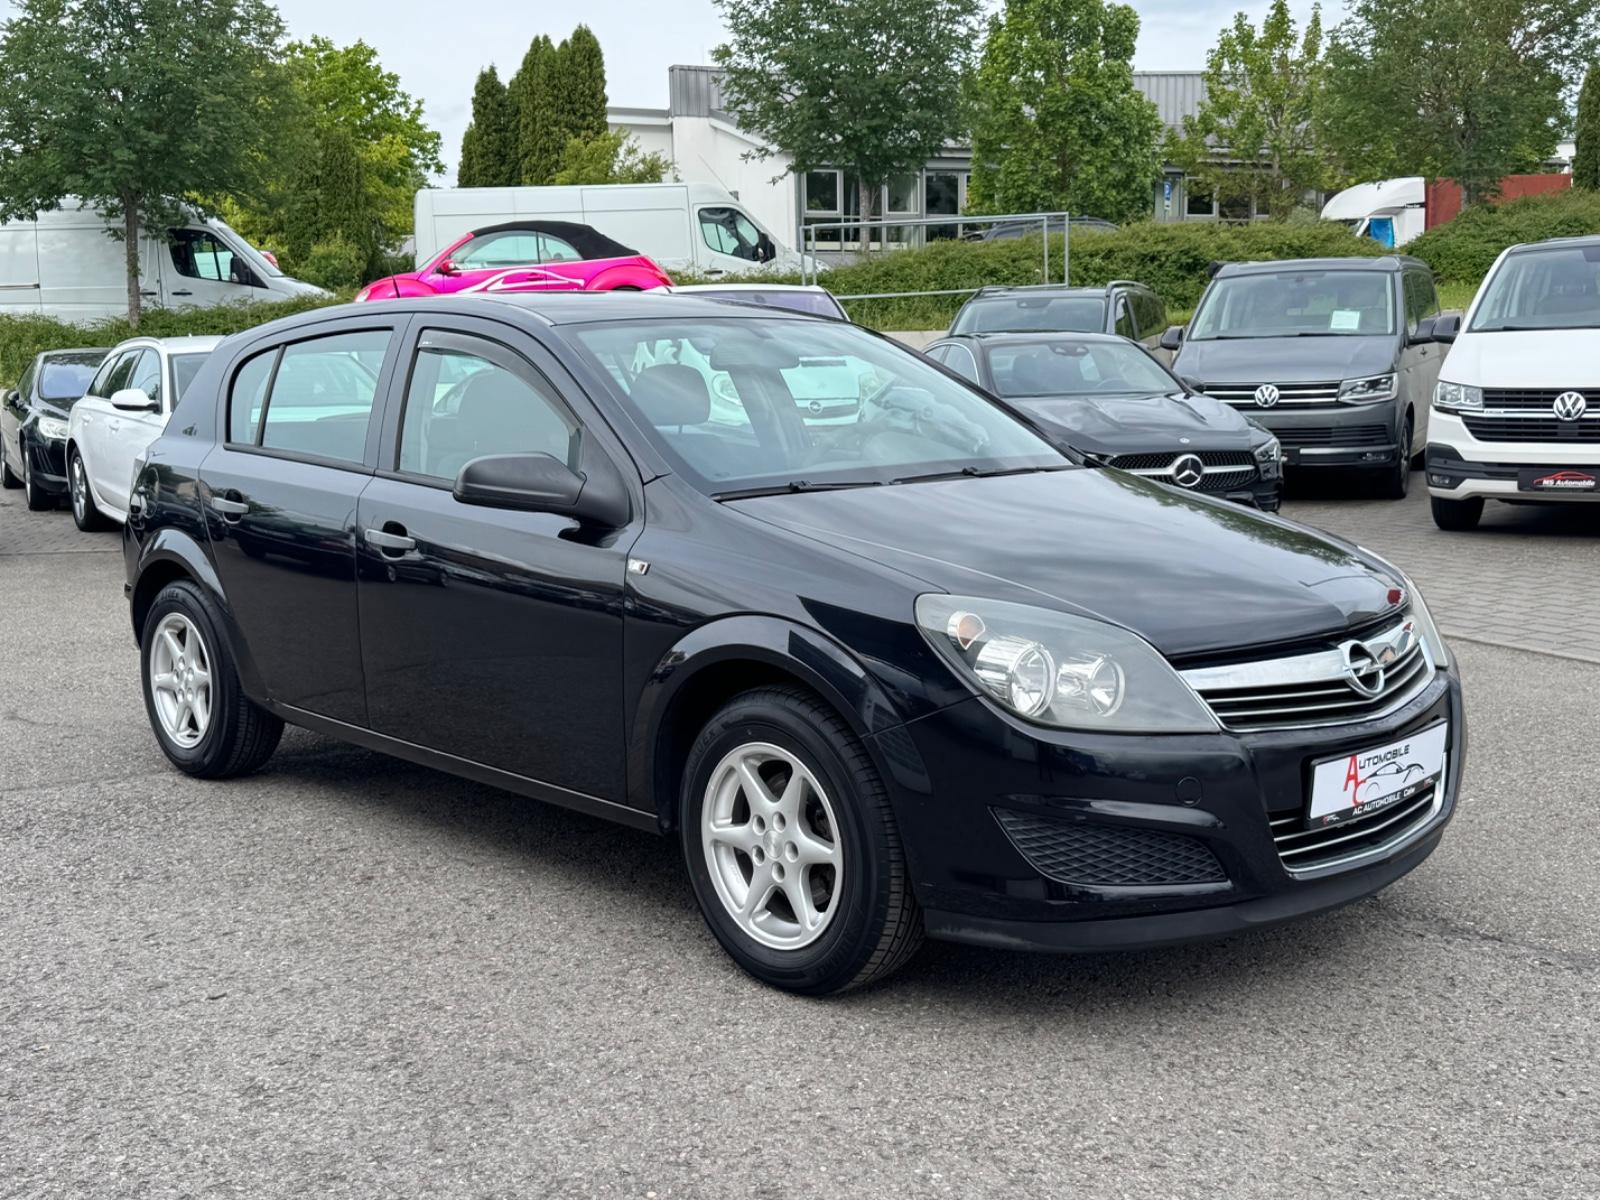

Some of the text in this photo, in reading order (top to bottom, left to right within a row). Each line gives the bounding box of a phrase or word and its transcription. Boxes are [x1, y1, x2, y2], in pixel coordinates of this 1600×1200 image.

[1553, 391, 1586, 421] VW
[1555, 479, 1596, 487] Automobile
[1353, 806, 1363, 815] AC
[1364, 792, 1401, 811] AUTOMOBILE
